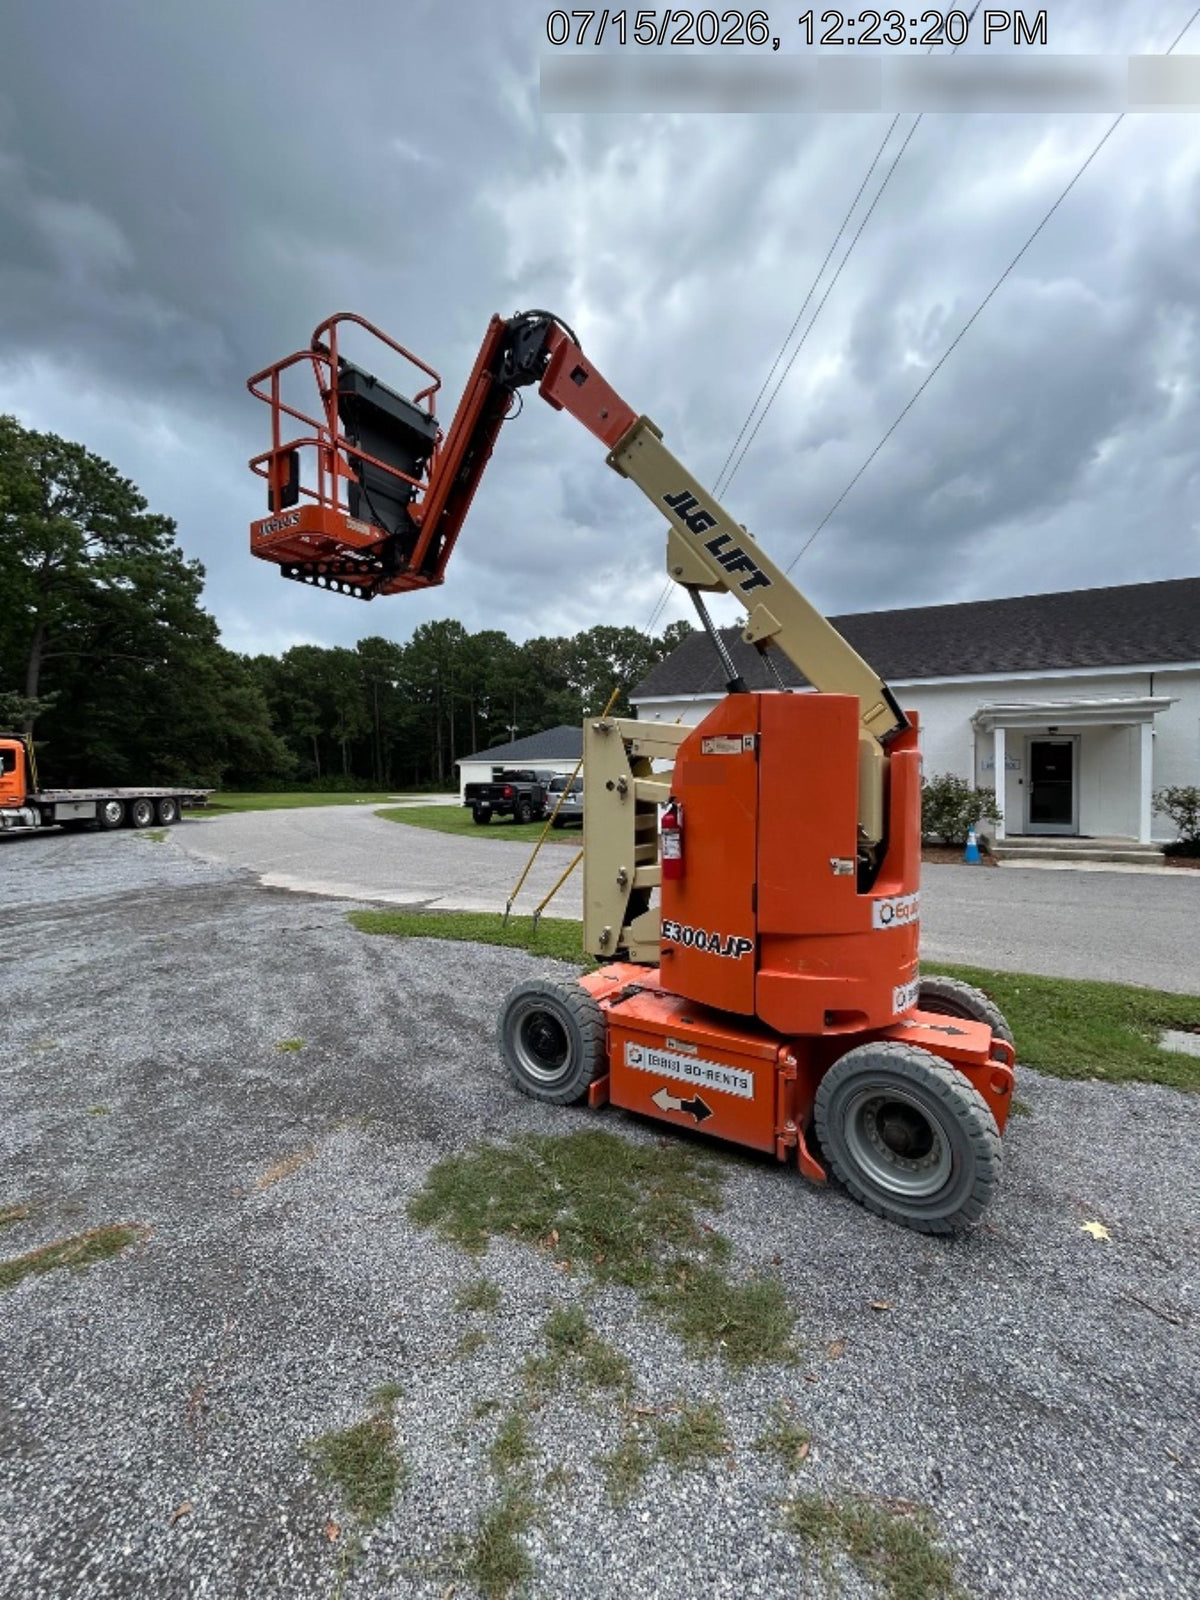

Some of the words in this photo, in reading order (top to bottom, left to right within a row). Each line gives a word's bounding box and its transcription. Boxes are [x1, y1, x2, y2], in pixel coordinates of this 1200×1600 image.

[662, 489, 719, 535] JLG
[703, 533, 772, 592] LIFT
[661, 919, 754, 960] E300AJP
